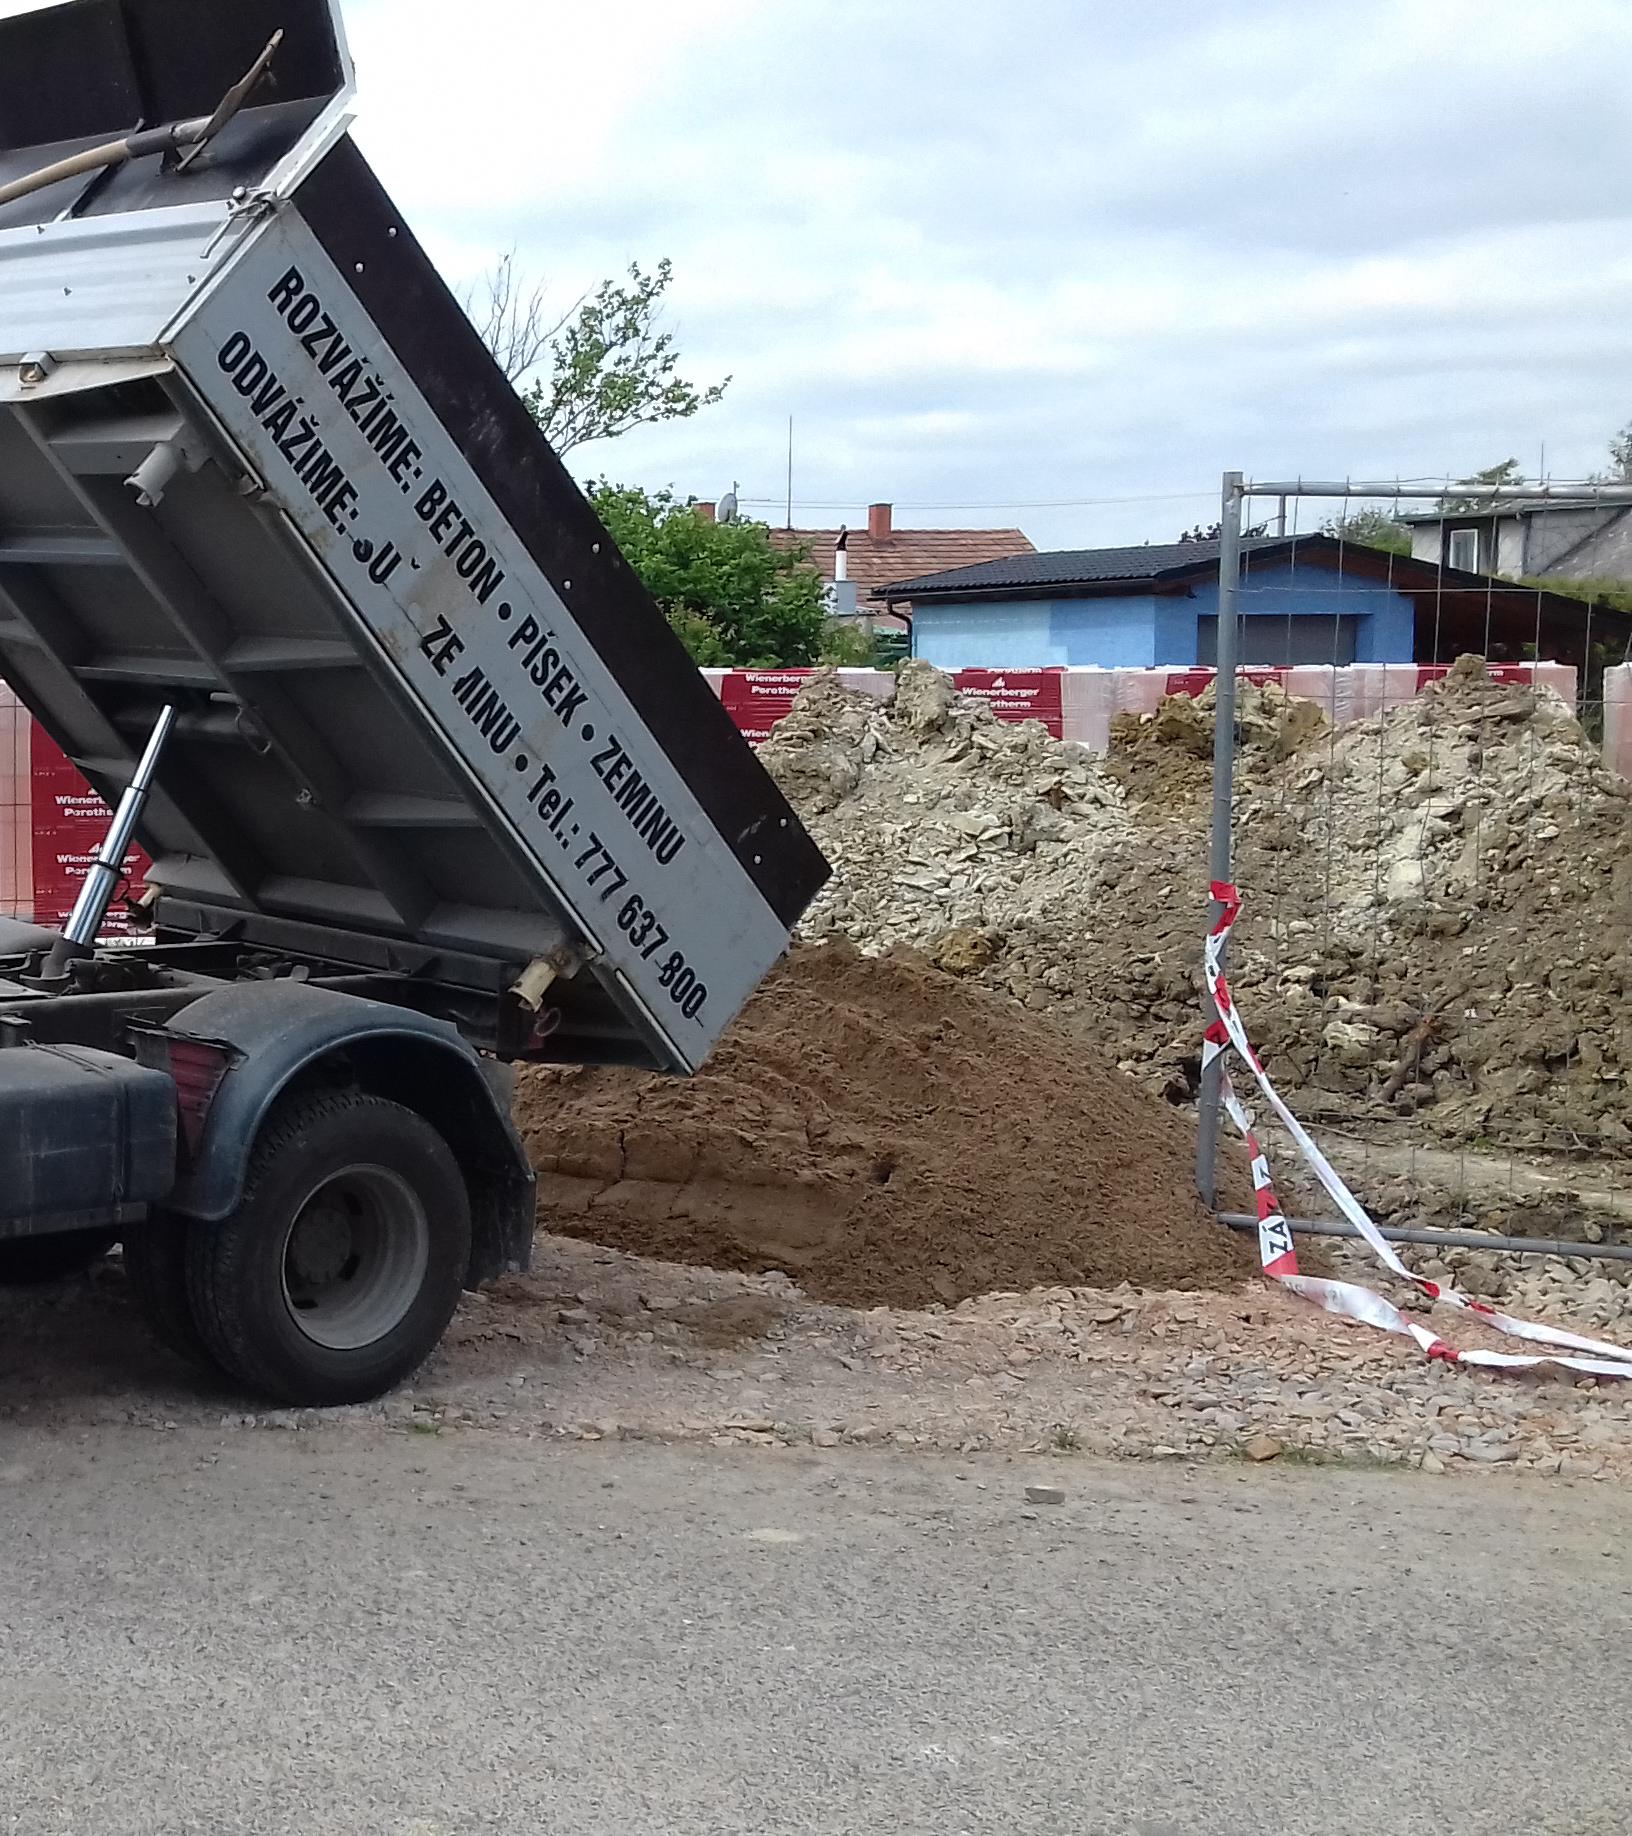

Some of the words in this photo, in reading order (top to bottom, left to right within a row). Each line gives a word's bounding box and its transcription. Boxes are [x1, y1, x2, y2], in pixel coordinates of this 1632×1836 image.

[414, 478, 505, 605] BETON
[507, 614, 589, 728] PÍSEK
[589, 734, 686, 866] ZEMINU
[961, 687, 1040, 697] Wienerberger
[574, 832, 628, 901] 777
[617, 894, 669, 961] 637
[658, 951, 707, 1020] 800
